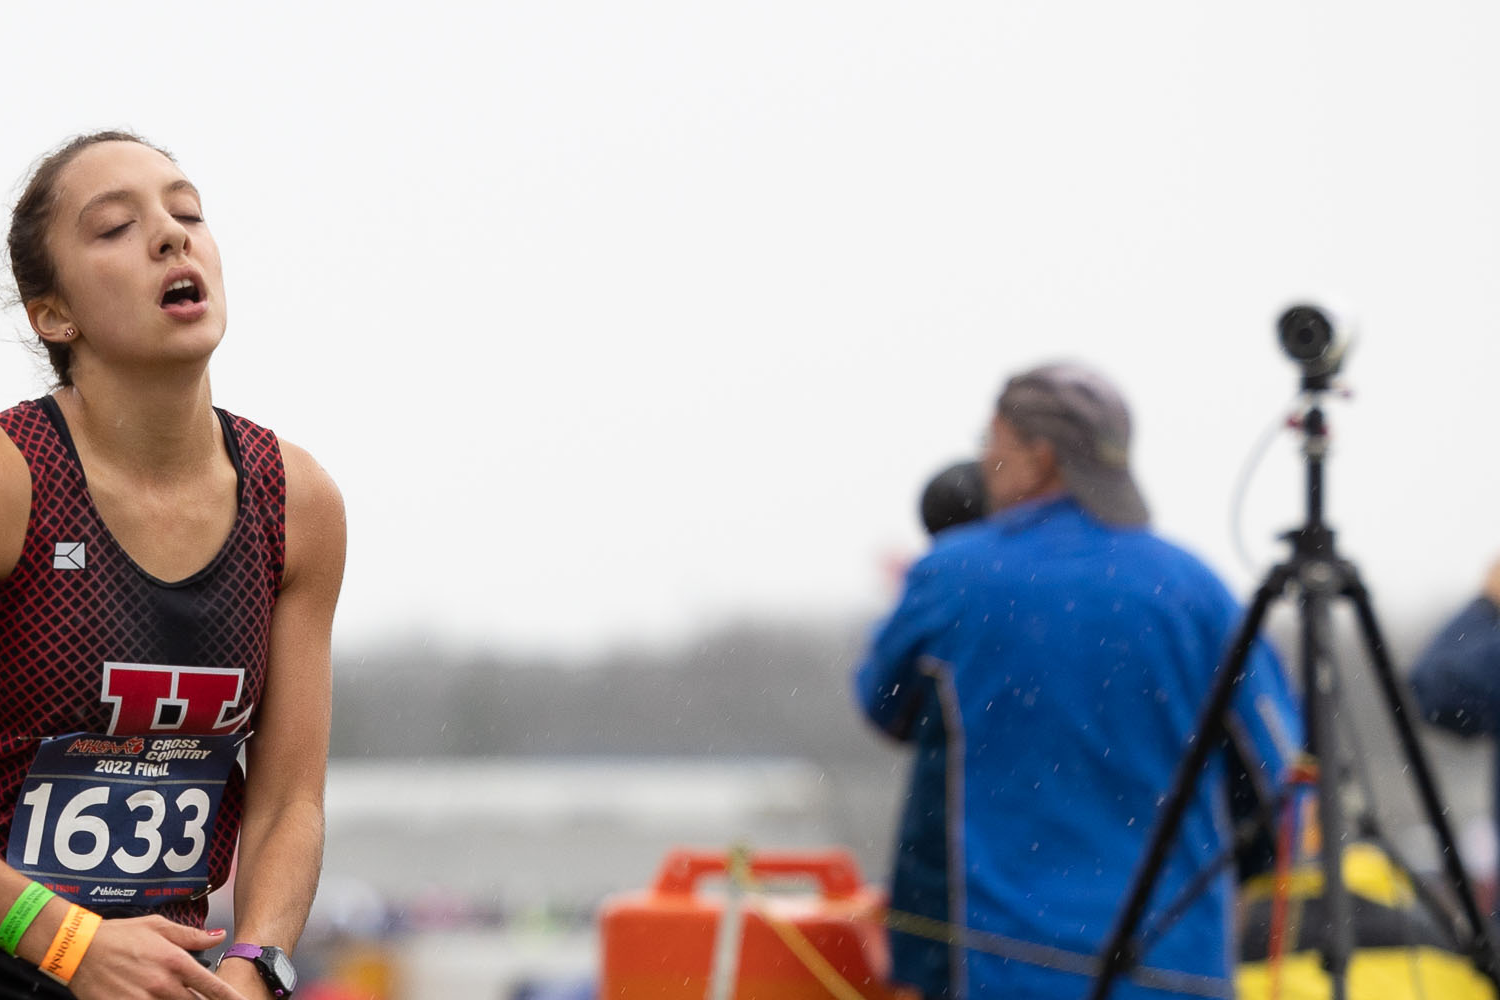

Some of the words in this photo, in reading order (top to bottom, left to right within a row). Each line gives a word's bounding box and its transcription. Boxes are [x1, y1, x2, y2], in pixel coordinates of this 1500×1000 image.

[151, 739, 200, 751] CROSS
[145, 749, 212, 761] COUNTRY
[94, 760, 132, 775] 2022
[134, 762, 170, 777] FINAL
[22, 783, 211, 874] 1633
